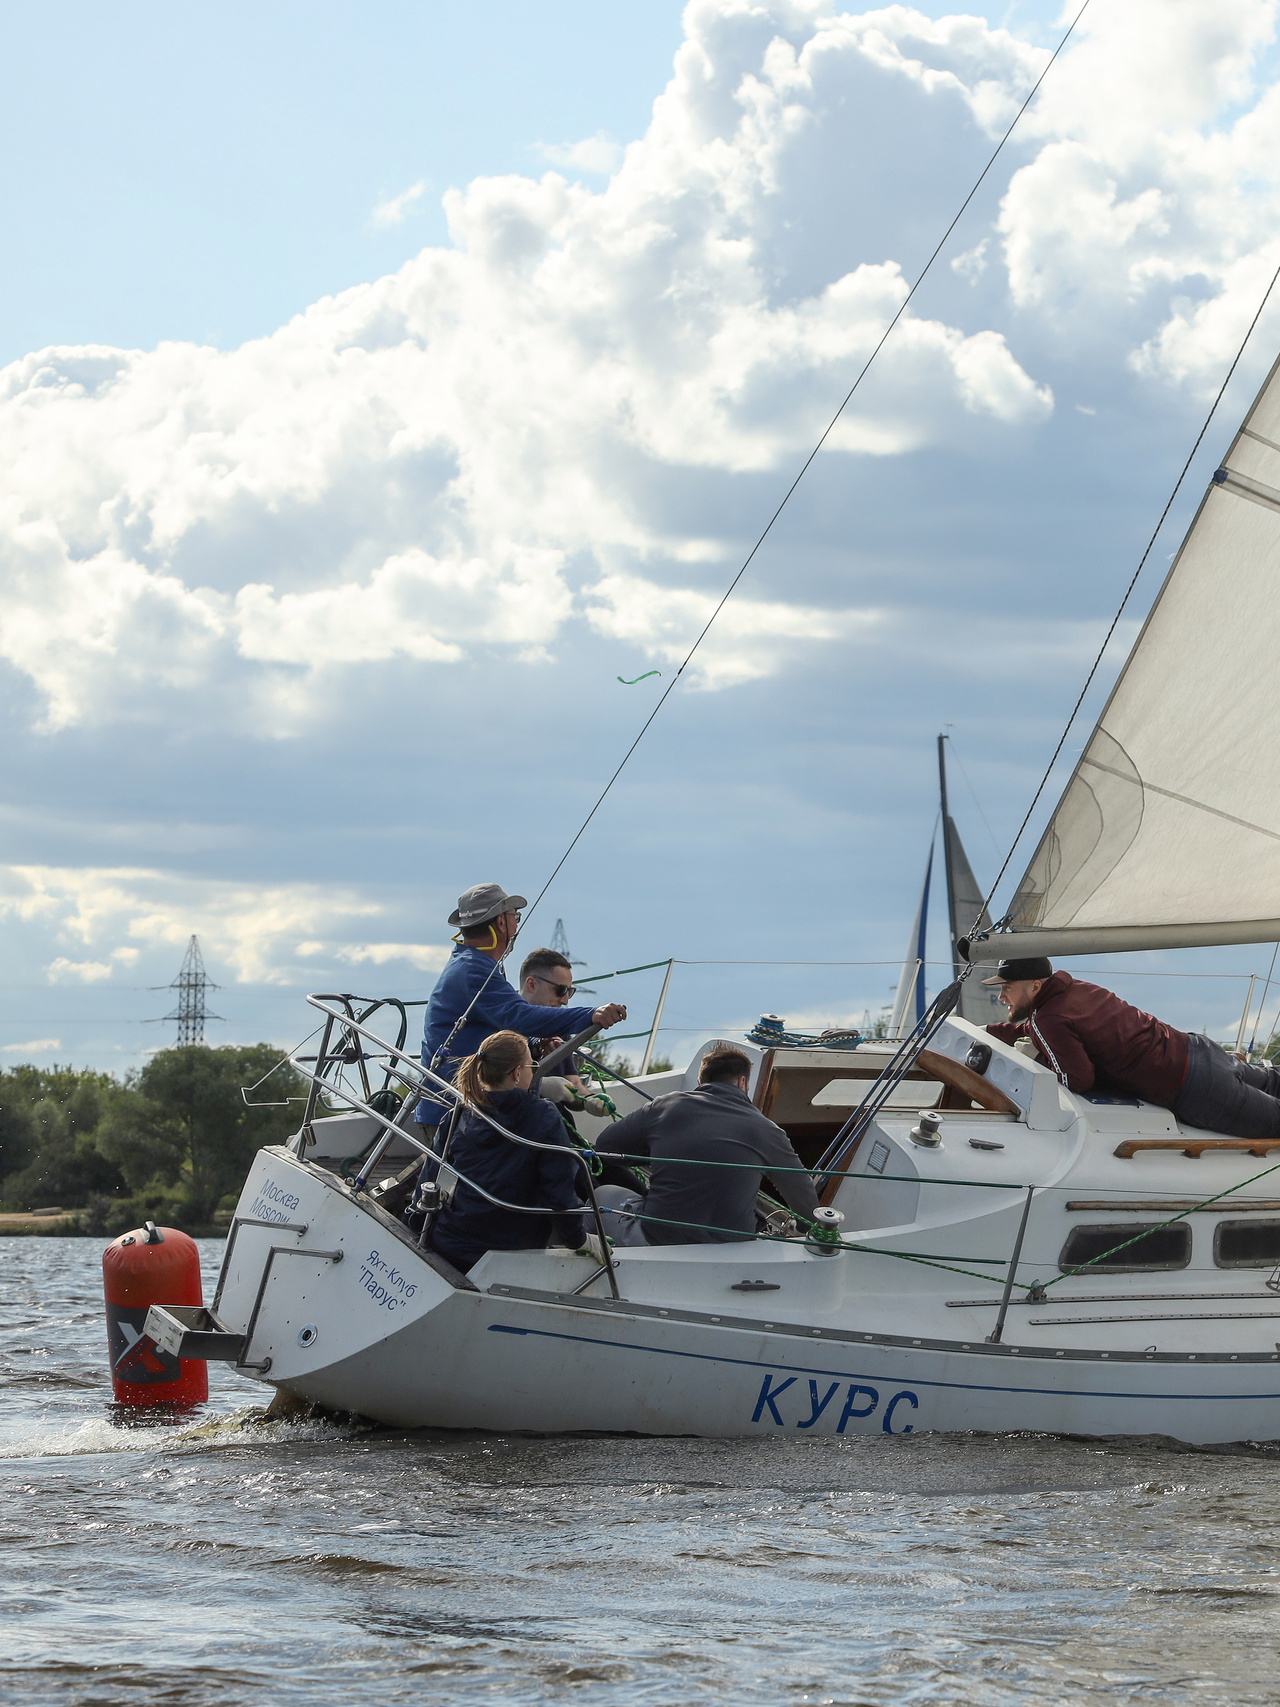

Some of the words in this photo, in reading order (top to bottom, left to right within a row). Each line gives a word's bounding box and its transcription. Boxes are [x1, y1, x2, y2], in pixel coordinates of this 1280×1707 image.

[260, 1178, 300, 1211] Москва
[359, 1265, 407, 1311] "Парус"
[366, 1250, 418, 1298] Яхт-Клуб
[751, 1374, 919, 1434] КУРС
